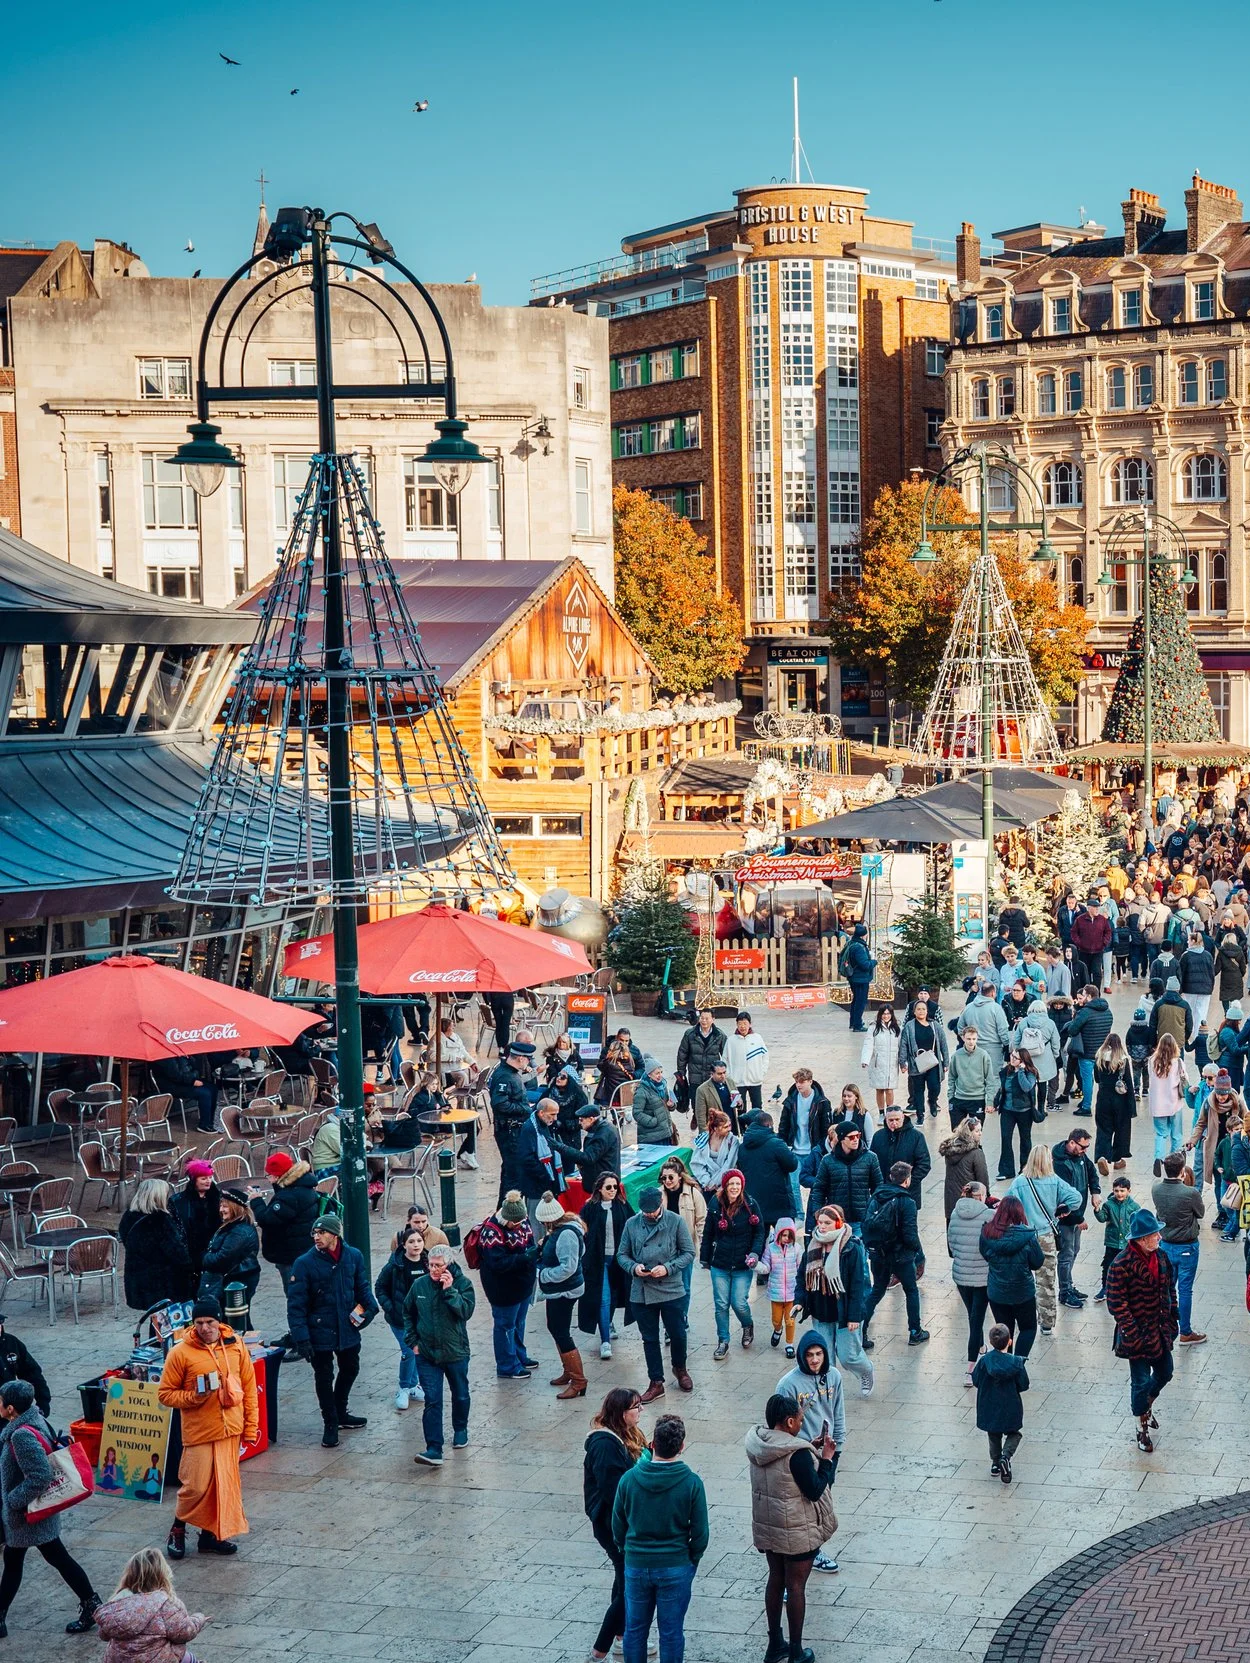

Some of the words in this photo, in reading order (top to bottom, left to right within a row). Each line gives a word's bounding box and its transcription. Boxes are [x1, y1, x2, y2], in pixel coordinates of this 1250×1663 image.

[740, 205, 796, 225] BRISTOL
[801, 205, 809, 221] &
[815, 205, 856, 225] WEST
[769, 226, 819, 243] HOUSE
[771, 649, 782, 657] BE
[786, 649, 798, 657] AT
[801, 649, 822, 657] ONE
[751, 855, 837, 868] Bournemouth
[736, 867, 799, 880] Christmas
[802, 867, 851, 880] Market
[409, 969, 479, 983] Coca-Cola
[572, 998, 600, 1008] Coca-Cola
[165, 1023, 240, 1044] Coca-Cola
[128, 1396, 151, 1407] YOGA
[111, 1409, 164, 1423] MEDITATION
[107, 1423, 163, 1438] SPIRITUALITY
[116, 1439, 151, 1452] WISDOM
